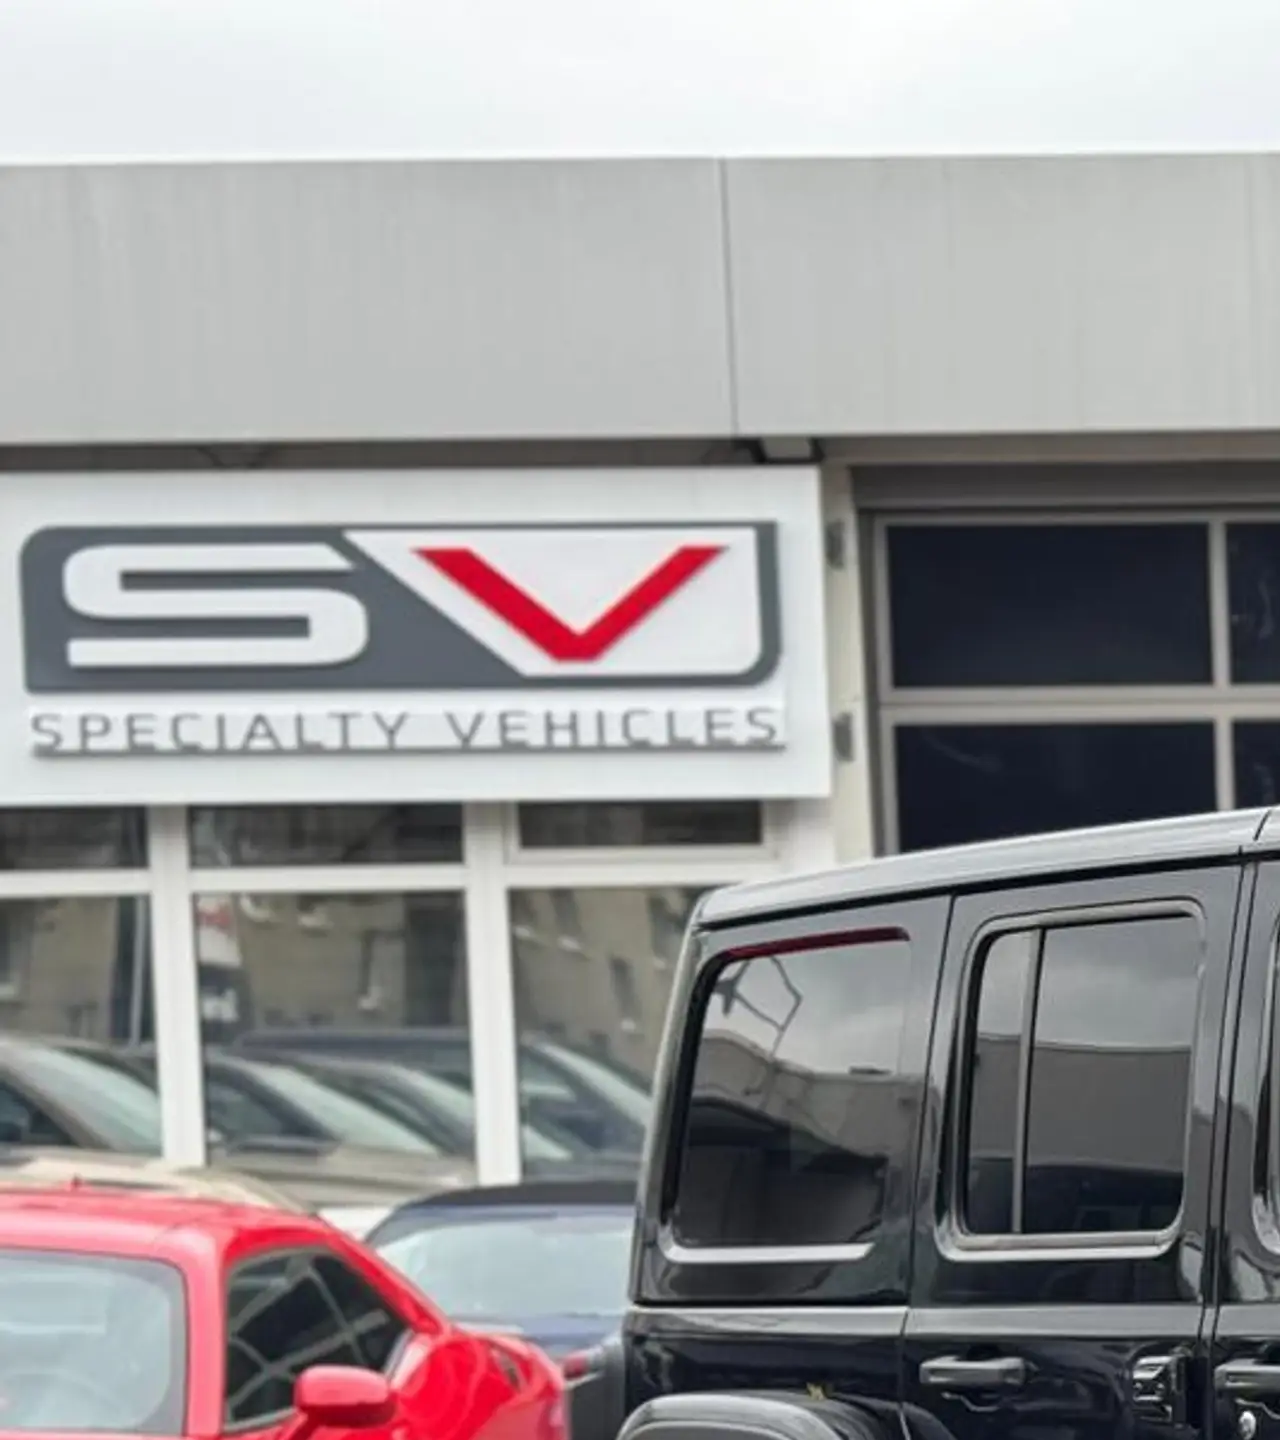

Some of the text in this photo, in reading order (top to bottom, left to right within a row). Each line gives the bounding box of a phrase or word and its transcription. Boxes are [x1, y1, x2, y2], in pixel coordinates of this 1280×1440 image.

[62, 543, 730, 668] SV
[30, 706, 777, 752] SPECIALTY VEHICLES
